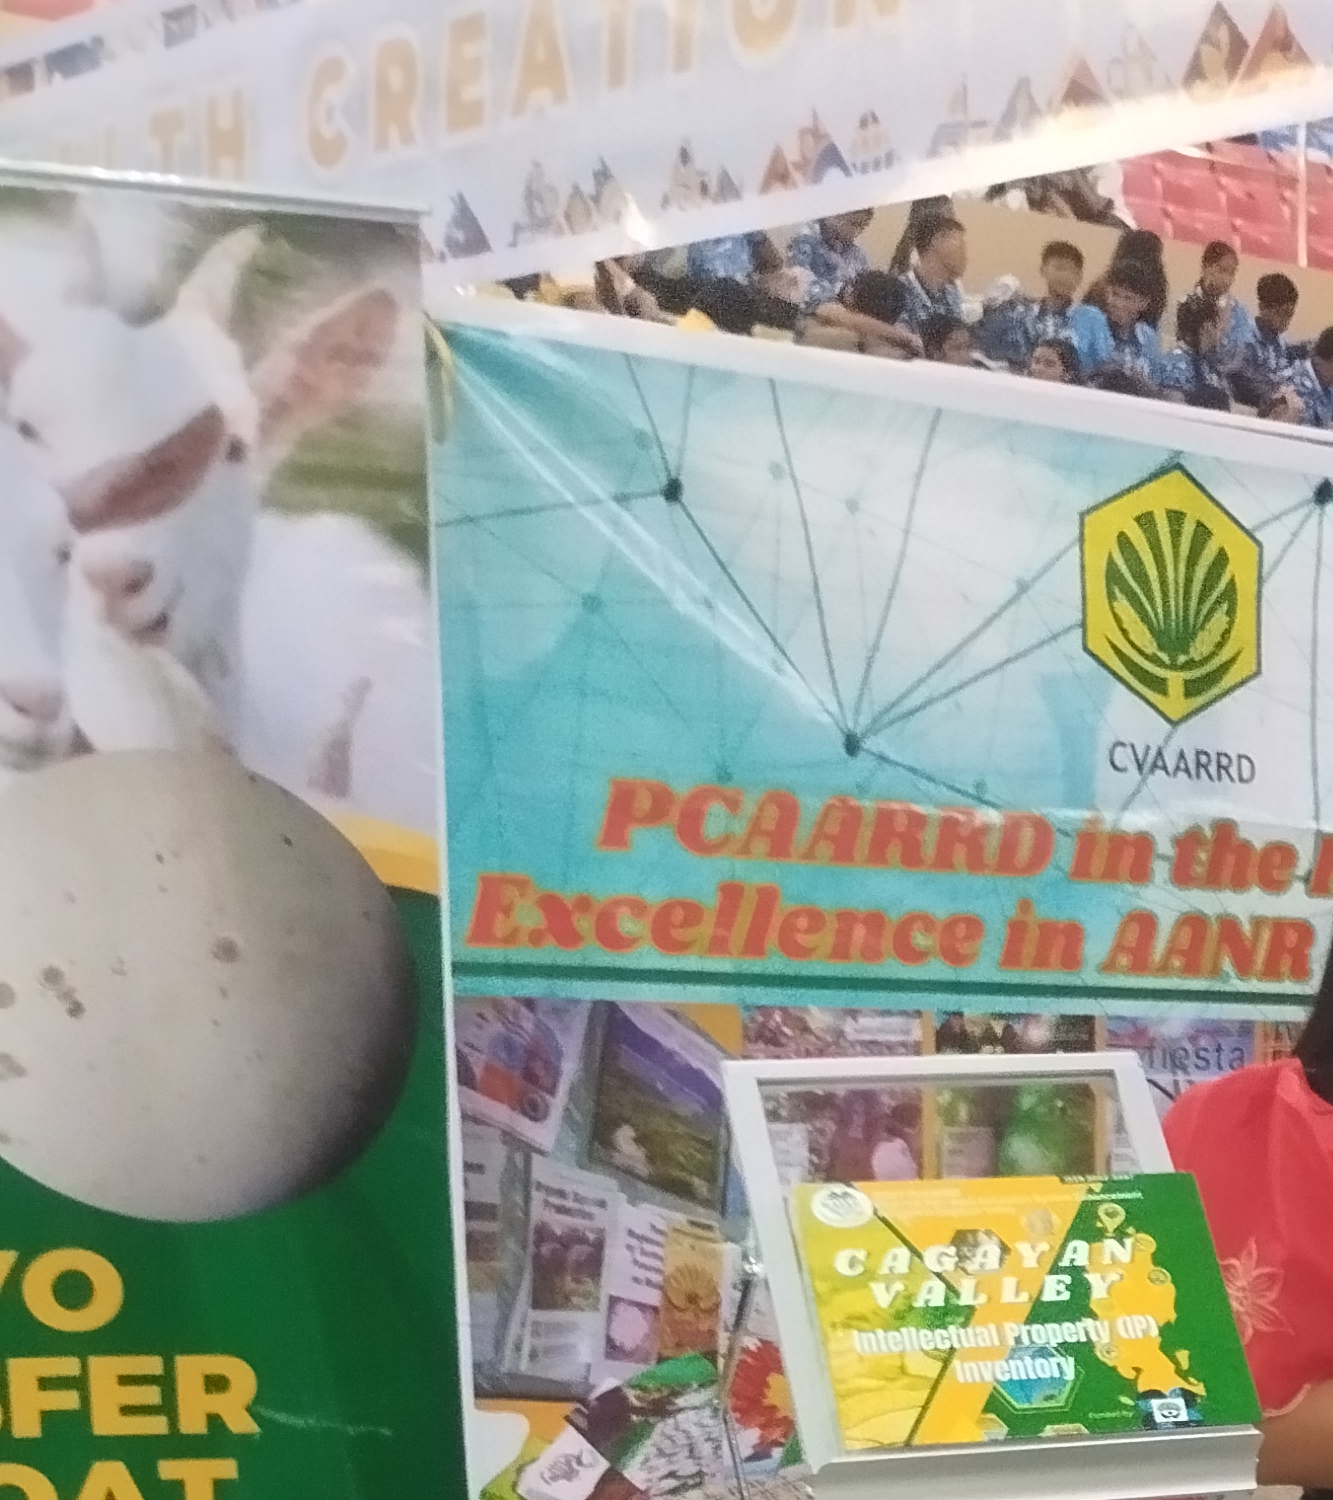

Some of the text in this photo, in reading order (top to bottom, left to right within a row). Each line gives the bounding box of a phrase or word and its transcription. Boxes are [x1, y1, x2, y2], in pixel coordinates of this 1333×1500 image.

[1108, 740, 1257, 785] CVAARRD
[597, 779, 1056, 878] PCAARRD
[1067, 812, 1156, 888] in
[1169, 817, 1300, 896] the
[466, 872, 986, 968] Excellence
[996, 898, 1085, 972] in
[1099, 908, 1318, 984] AANR
[832, 1238, 1137, 1277] CAGAYAN
[870, 1270, 1124, 1310] VALLEY
[852, 1325, 1000, 1353] Intellectual
[1004, 1322, 1112, 1351] Property
[954, 1354, 1076, 1384] Inventory
[0, 1354, 260, 1438] FER
